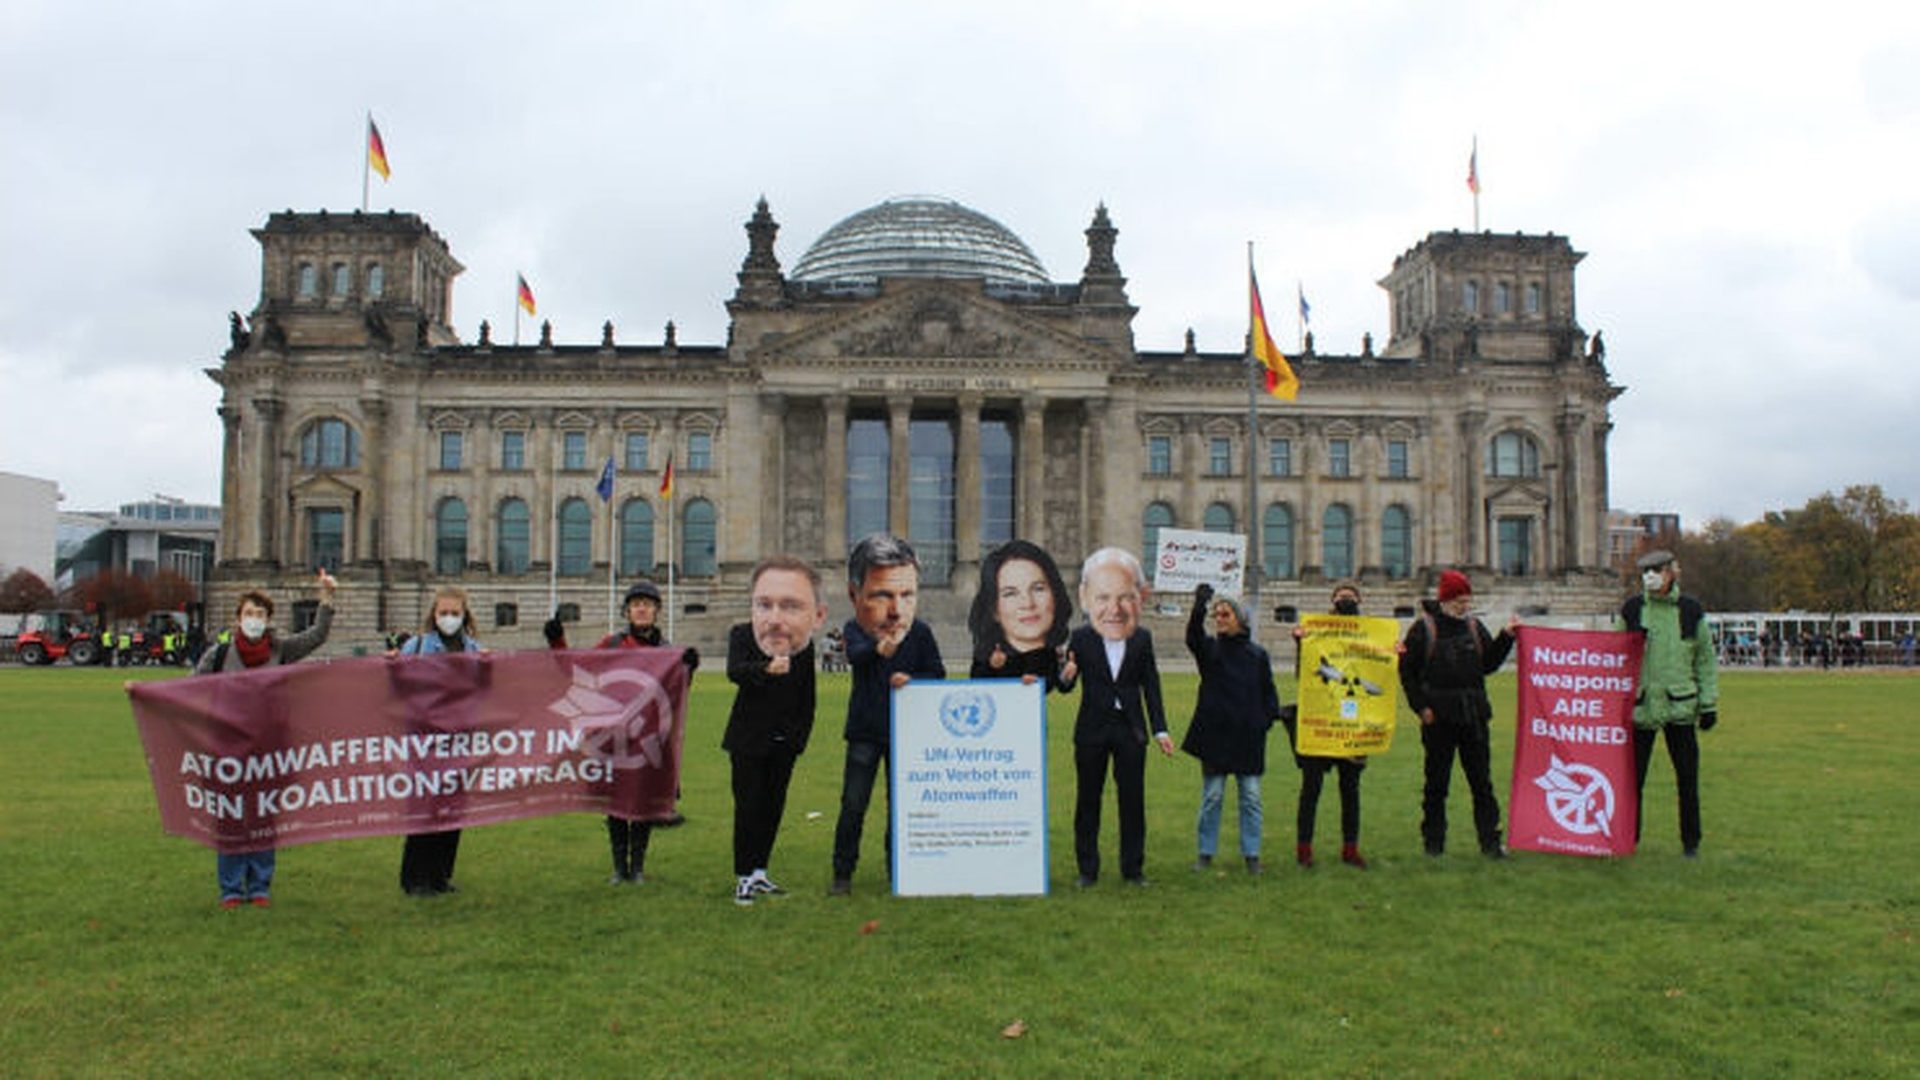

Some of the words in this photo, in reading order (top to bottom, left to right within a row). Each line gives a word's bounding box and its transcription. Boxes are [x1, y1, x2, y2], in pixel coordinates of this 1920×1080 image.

[1534, 646, 1627, 668] Nuclear
[1530, 673, 1632, 693] weapons
[1553, 698, 1603, 717] ARE
[1532, 716, 1627, 744] BANNED
[180, 728, 536, 784] ATOMWAFFENVERBOT
[546, 728, 583, 754] IN
[925, 747, 1014, 763] UN-Vertrag
[909, 770, 940, 782] zum
[946, 768, 997, 782] Verbot
[1003, 770, 1031, 781] von
[185, 783, 243, 819] DEN
[257, 757, 614, 817] KOALITIONSVERTRAG!
[922, 788, 1018, 801] Atomwaffen
